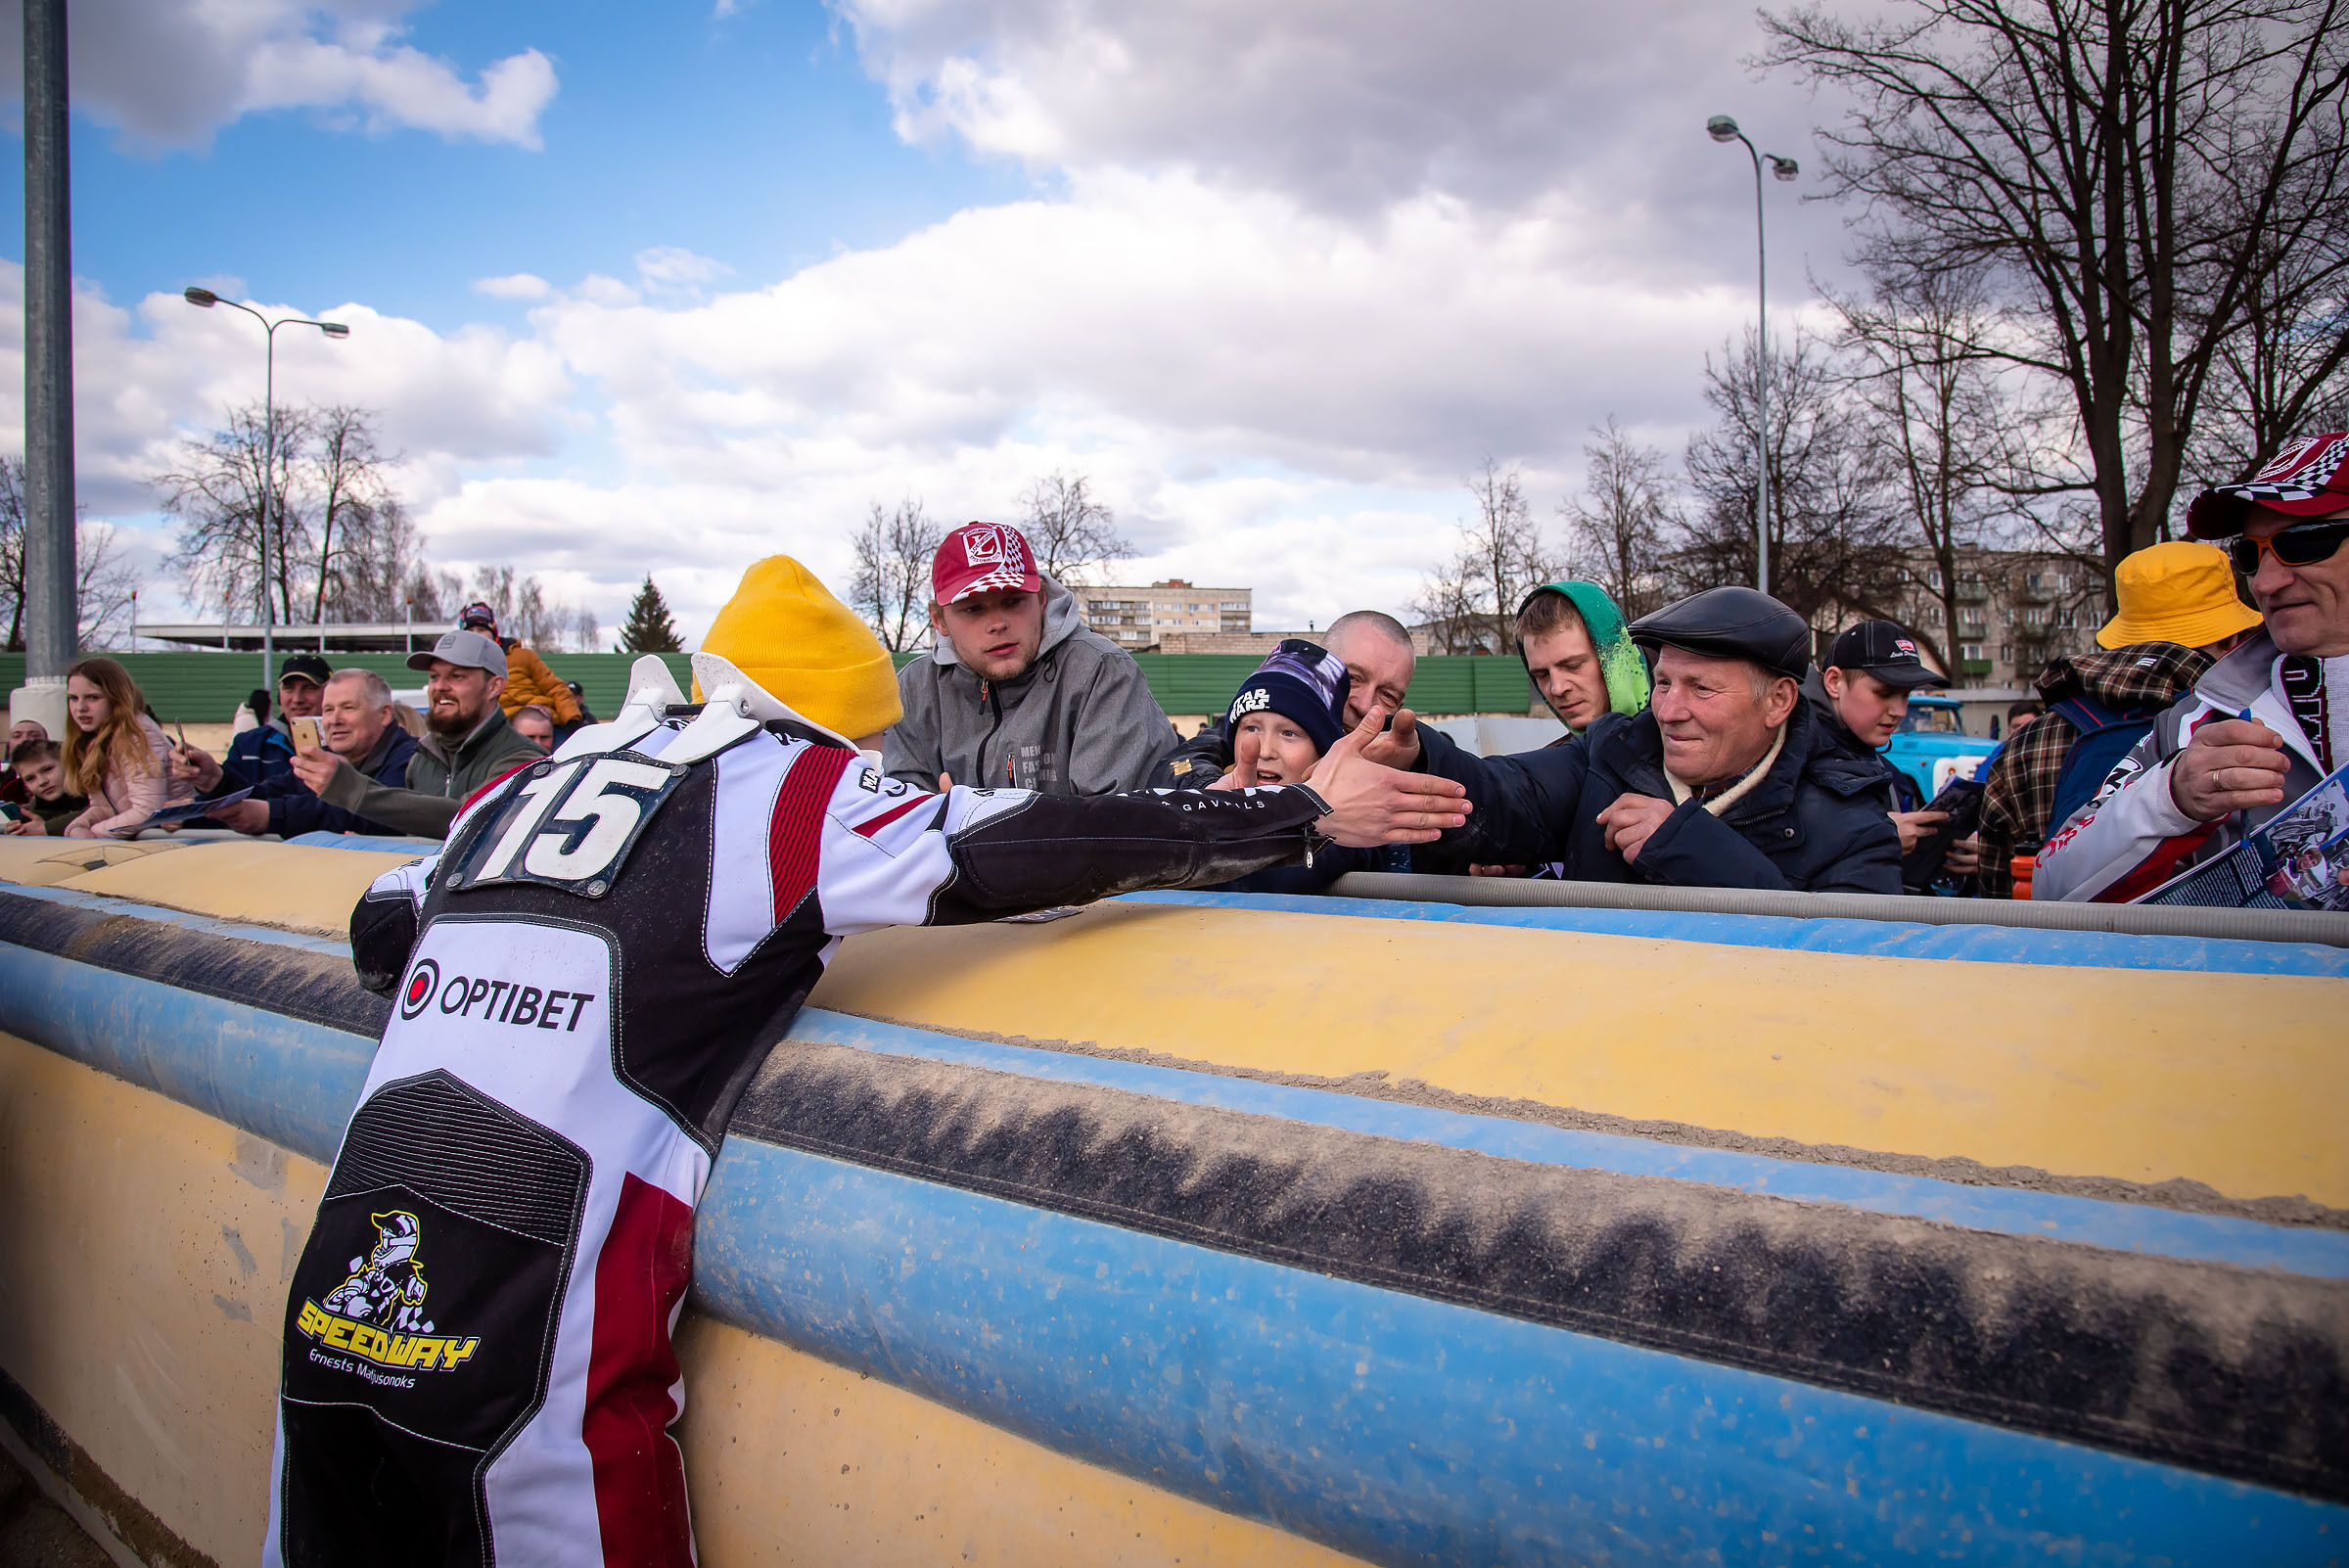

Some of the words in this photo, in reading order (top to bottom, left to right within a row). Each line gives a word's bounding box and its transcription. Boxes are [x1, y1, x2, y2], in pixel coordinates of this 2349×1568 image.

[1229, 698, 1269, 723] WARS
[1020, 745, 1041, 758] MEN
[475, 759, 671, 882] 15
[440, 976, 595, 1032] OPTIBET
[297, 1299, 480, 1370] SPEEDWAY
[309, 1348, 354, 1372] Ernests
